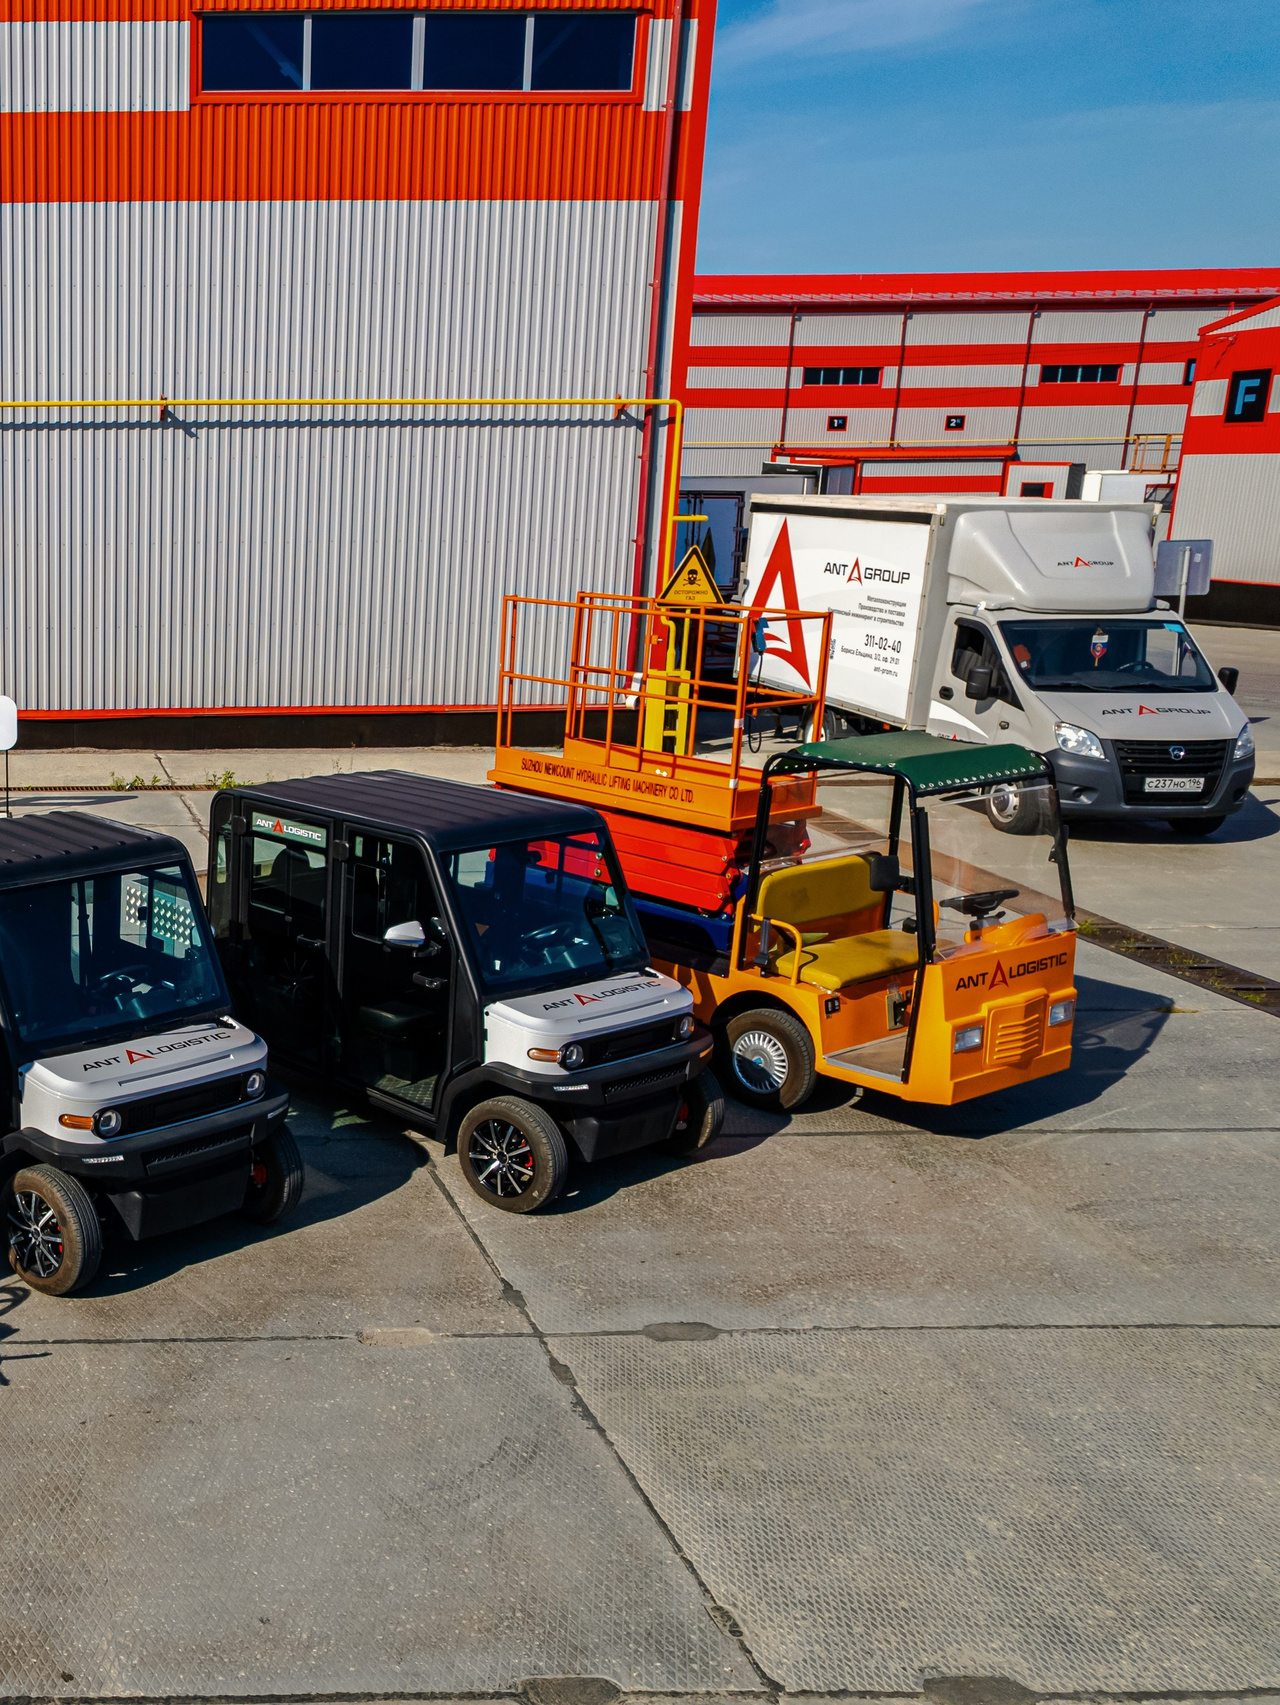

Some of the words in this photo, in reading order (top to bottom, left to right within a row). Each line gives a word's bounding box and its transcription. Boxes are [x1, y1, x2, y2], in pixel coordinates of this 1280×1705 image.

[1234, 378, 1261, 415] F
[824, 562, 848, 576] ANT
[864, 567, 910, 584] GROUP
[864, 634, 902, 653] 311-02-40
[1102, 708, 1133, 716] ANT
[521, 757, 543, 774] SUZHOU
[544, 763, 575, 780] NEWCOUNT
[576, 771, 608, 787] HYDRAULIC
[609, 777, 631, 792] LIFTING
[633, 780, 667, 798] MACHINERY
[669, 787, 679, 800] CO
[680, 788, 695, 804] LTD.
[256, 818, 274, 829] ANT
[284, 825, 322, 841] LOGISTIC
[955, 972, 989, 991] ANT
[1009, 952, 1068, 979] LOGISTIC
[542, 998, 575, 1011] ANT
[592, 980, 661, 998] LOGISTIC
[82, 1056, 121, 1072] ANT
[146, 1032, 231, 1055] LOGISTIC
